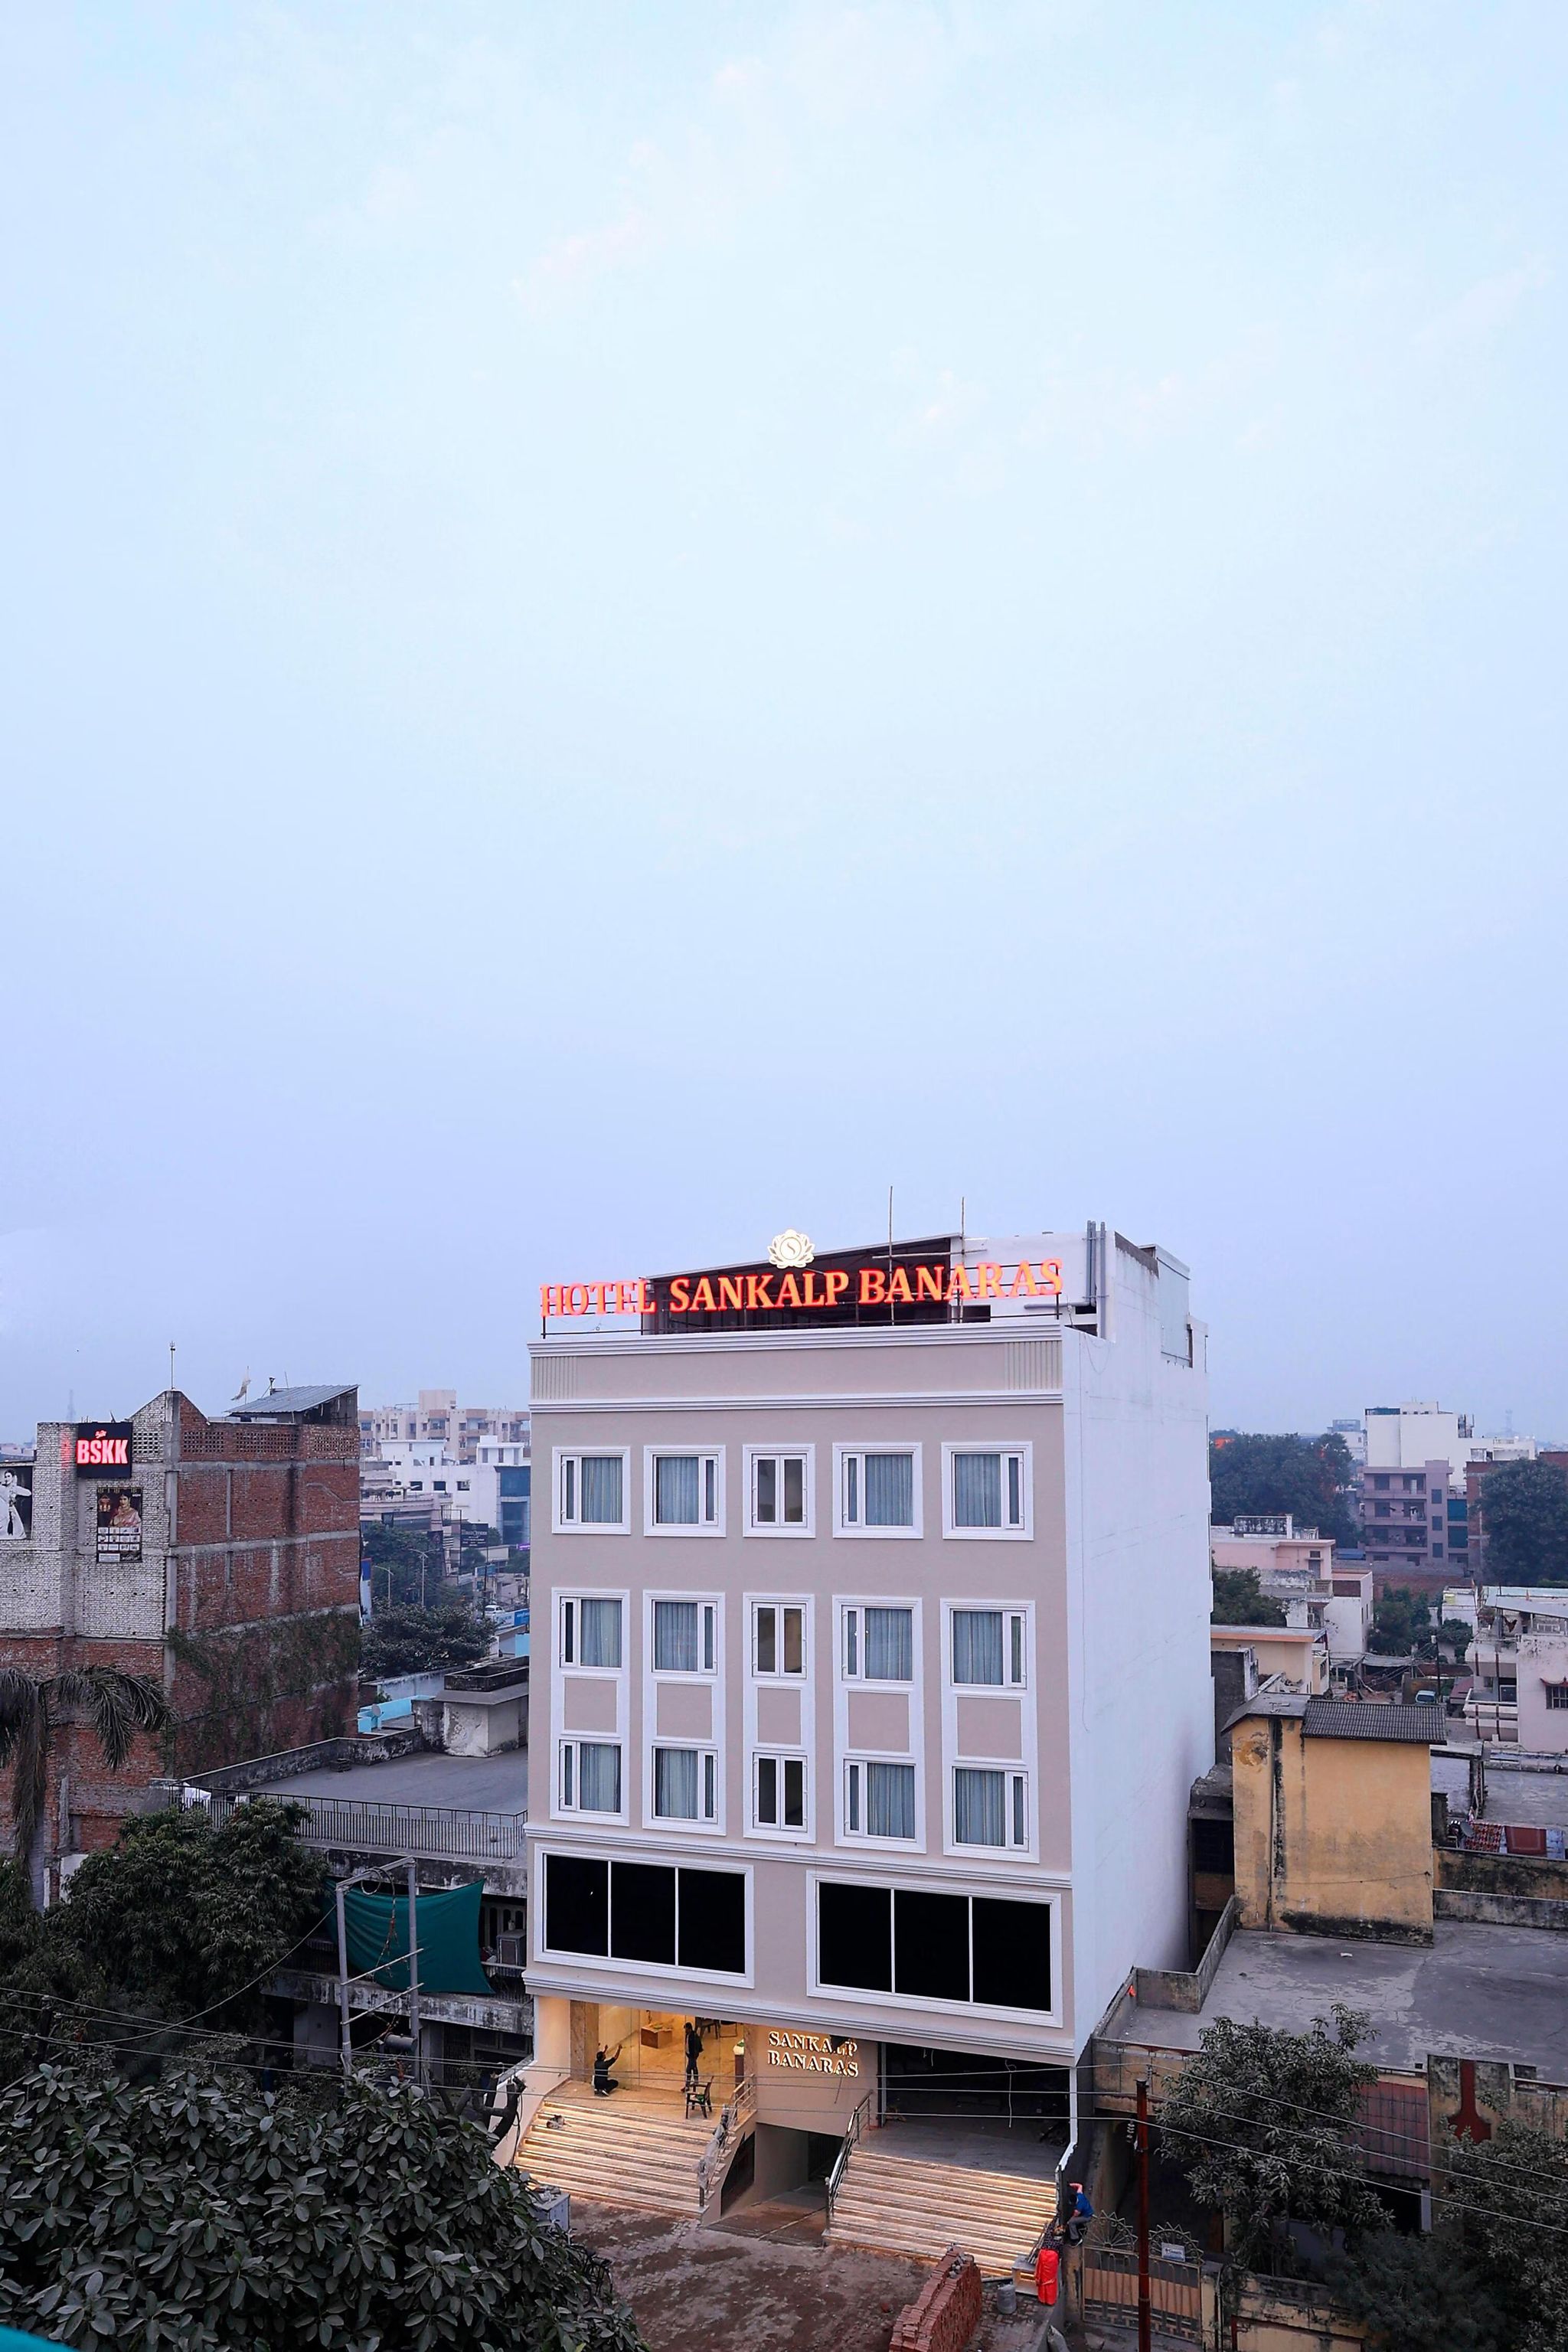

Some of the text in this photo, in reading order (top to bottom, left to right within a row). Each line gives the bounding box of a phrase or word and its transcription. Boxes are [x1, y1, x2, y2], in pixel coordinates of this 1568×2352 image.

[540, 1258, 1063, 1316] HOTEL SANKALP BANARAS
[77, 1439, 128, 1464] BSKK
[768, 2050, 858, 2077] BANARAS
